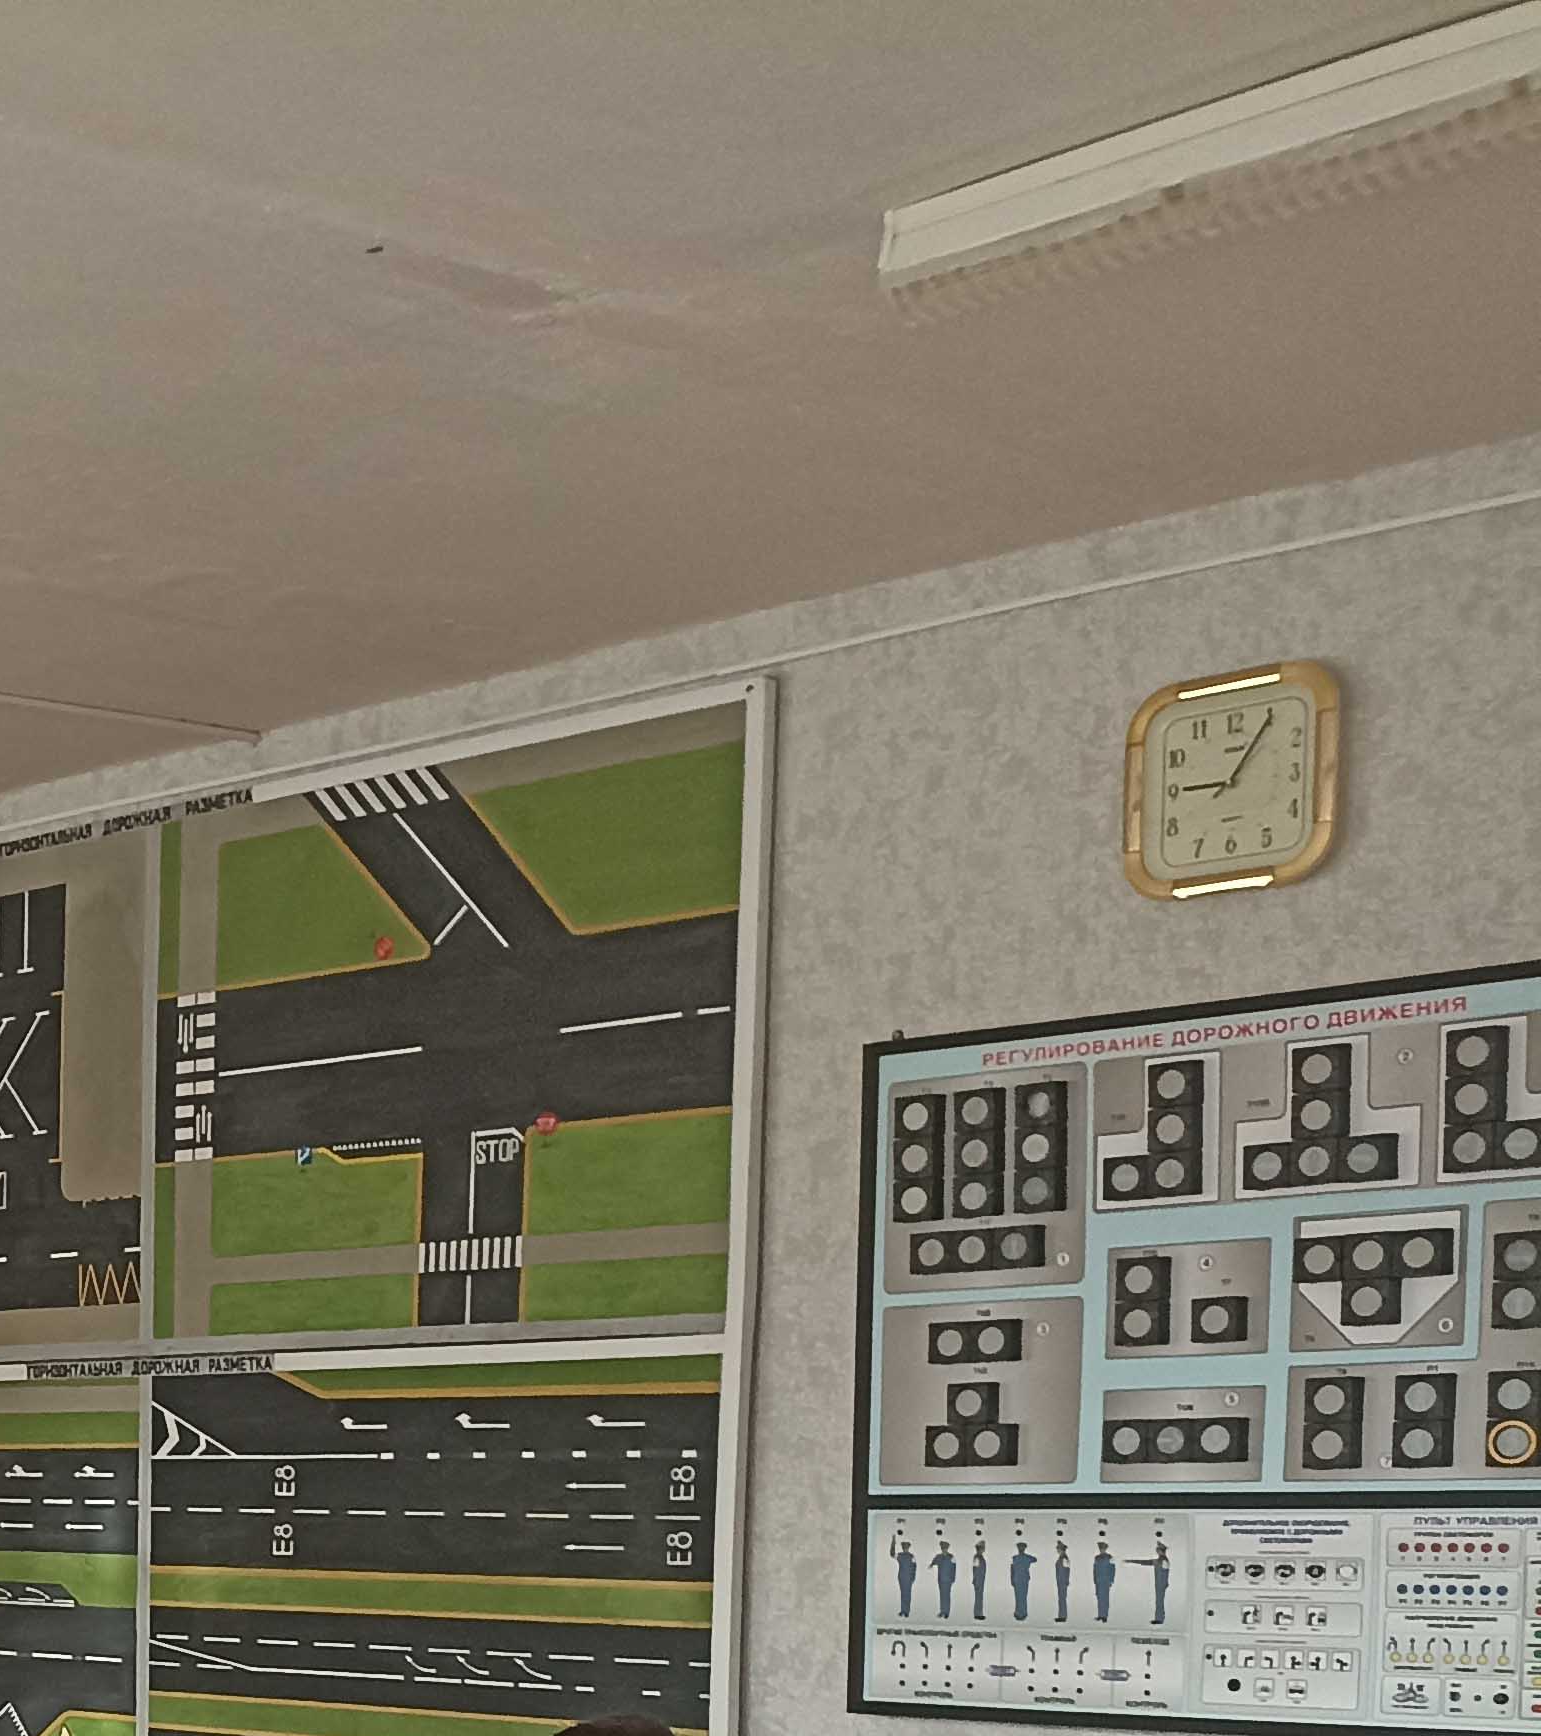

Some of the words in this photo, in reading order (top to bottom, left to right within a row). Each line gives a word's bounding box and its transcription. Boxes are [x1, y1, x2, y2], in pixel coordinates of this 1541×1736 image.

[1191, 720, 1207, 740] 11
[1226, 712, 1244, 734] 12
[1291, 727, 1302, 748] 2
[1169, 748, 1186, 768] 10
[1289, 763, 1301, 782] 3
[102, 806, 172, 836] ДОРОЖНАЯ
[184, 788, 253, 816] РАЗМЕТКА
[1288, 798, 1299, 818] 4
[1167, 817, 1179, 837] 8
[1261, 827, 1273, 848] 5
[1193, 838, 1205, 858] 7
[1225, 835, 1237, 854] 6
[982, 1033, 1165, 1067] РЕГУЛИРОВАНИЕ
[1171, 1015, 1320, 1048] ДОРОЖНОГО
[1327, 996, 1468, 1030] ДВИЖЕНИЯ
[474, 1137, 520, 1166] STOP
[27, 1362, 123, 1380] ГОРИЗОНТАЛЬНАЯ
[130, 1358, 200, 1376] ДОРОЖНАЯ
[208, 1355, 273, 1373] РАЗМЕТКА
[274, 1463, 297, 1498] E8
[670, 1463, 697, 1502] E8
[272, 1523, 295, 1557] E8
[666, 1530, 694, 1567] E8
